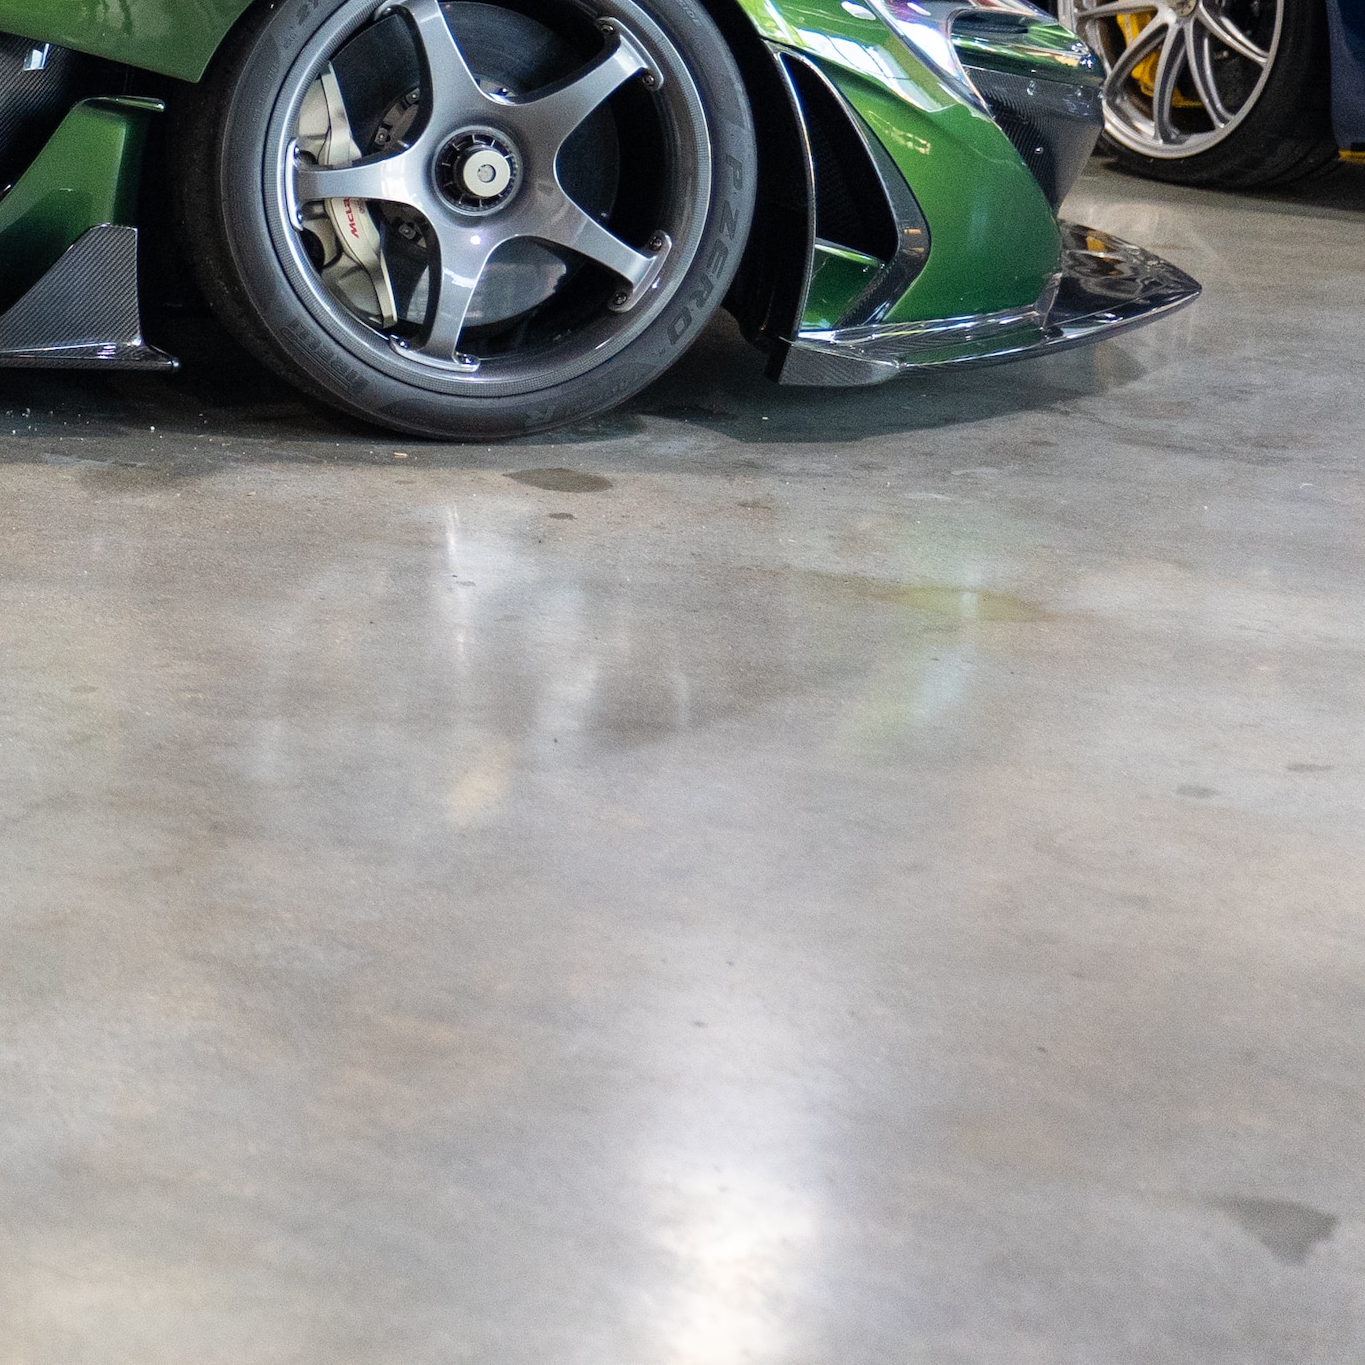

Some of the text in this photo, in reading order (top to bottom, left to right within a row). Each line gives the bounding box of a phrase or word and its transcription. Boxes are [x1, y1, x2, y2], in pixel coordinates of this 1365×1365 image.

[667, 153, 743, 346] P ZERO
[280, 319, 370, 398] PIRELLI
